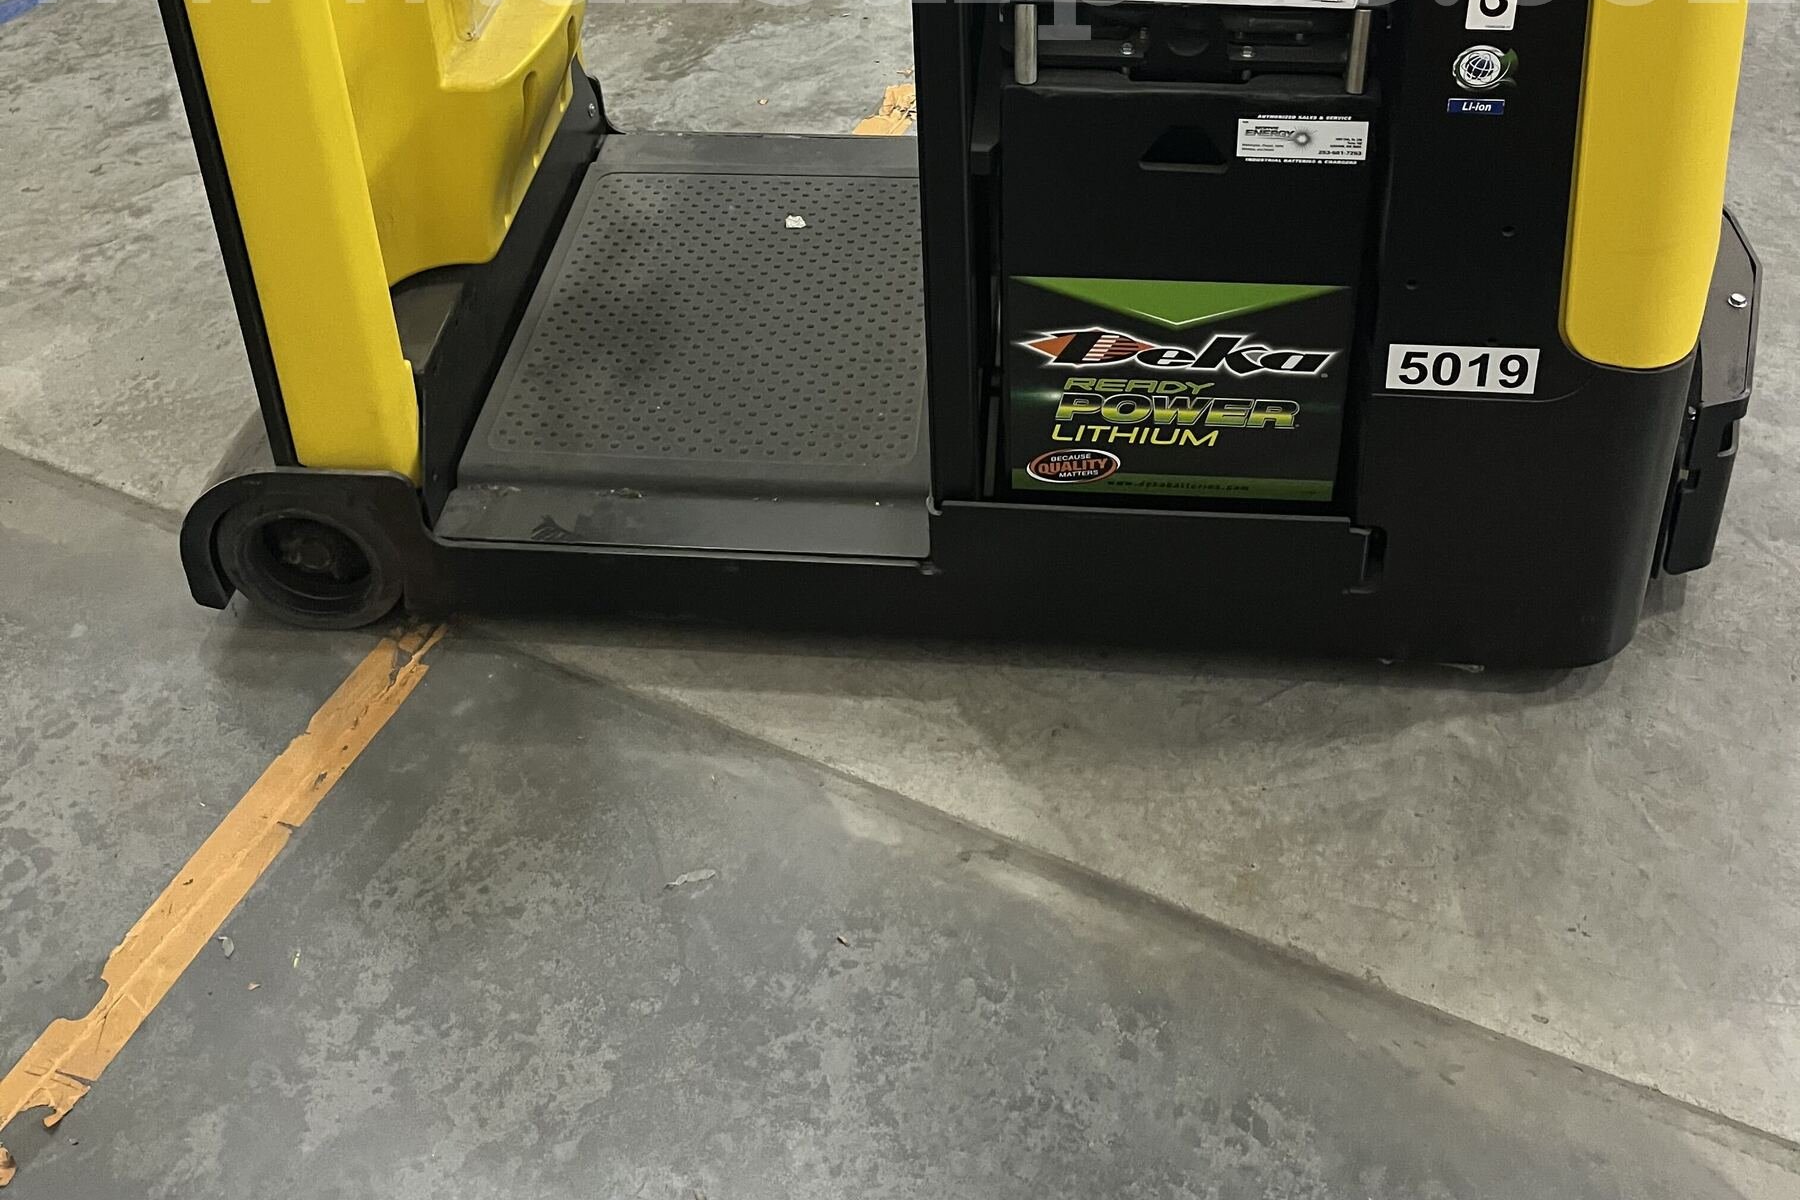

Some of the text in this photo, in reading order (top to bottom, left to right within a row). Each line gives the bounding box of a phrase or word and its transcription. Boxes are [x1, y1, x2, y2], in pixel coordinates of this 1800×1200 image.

[1245, 129, 1296, 138] ENERGY
[1048, 329, 1334, 375] Deka
[1398, 351, 1529, 389] 5019
[1063, 377, 1216, 394] READY
[1054, 392, 1301, 429] POWER
[1051, 424, 1220, 447] LITHIUM
[1038, 457, 1109, 476] QUALITY
[1050, 452, 1092, 462] BECAUSE
[1058, 469, 1099, 478] MATTERS
